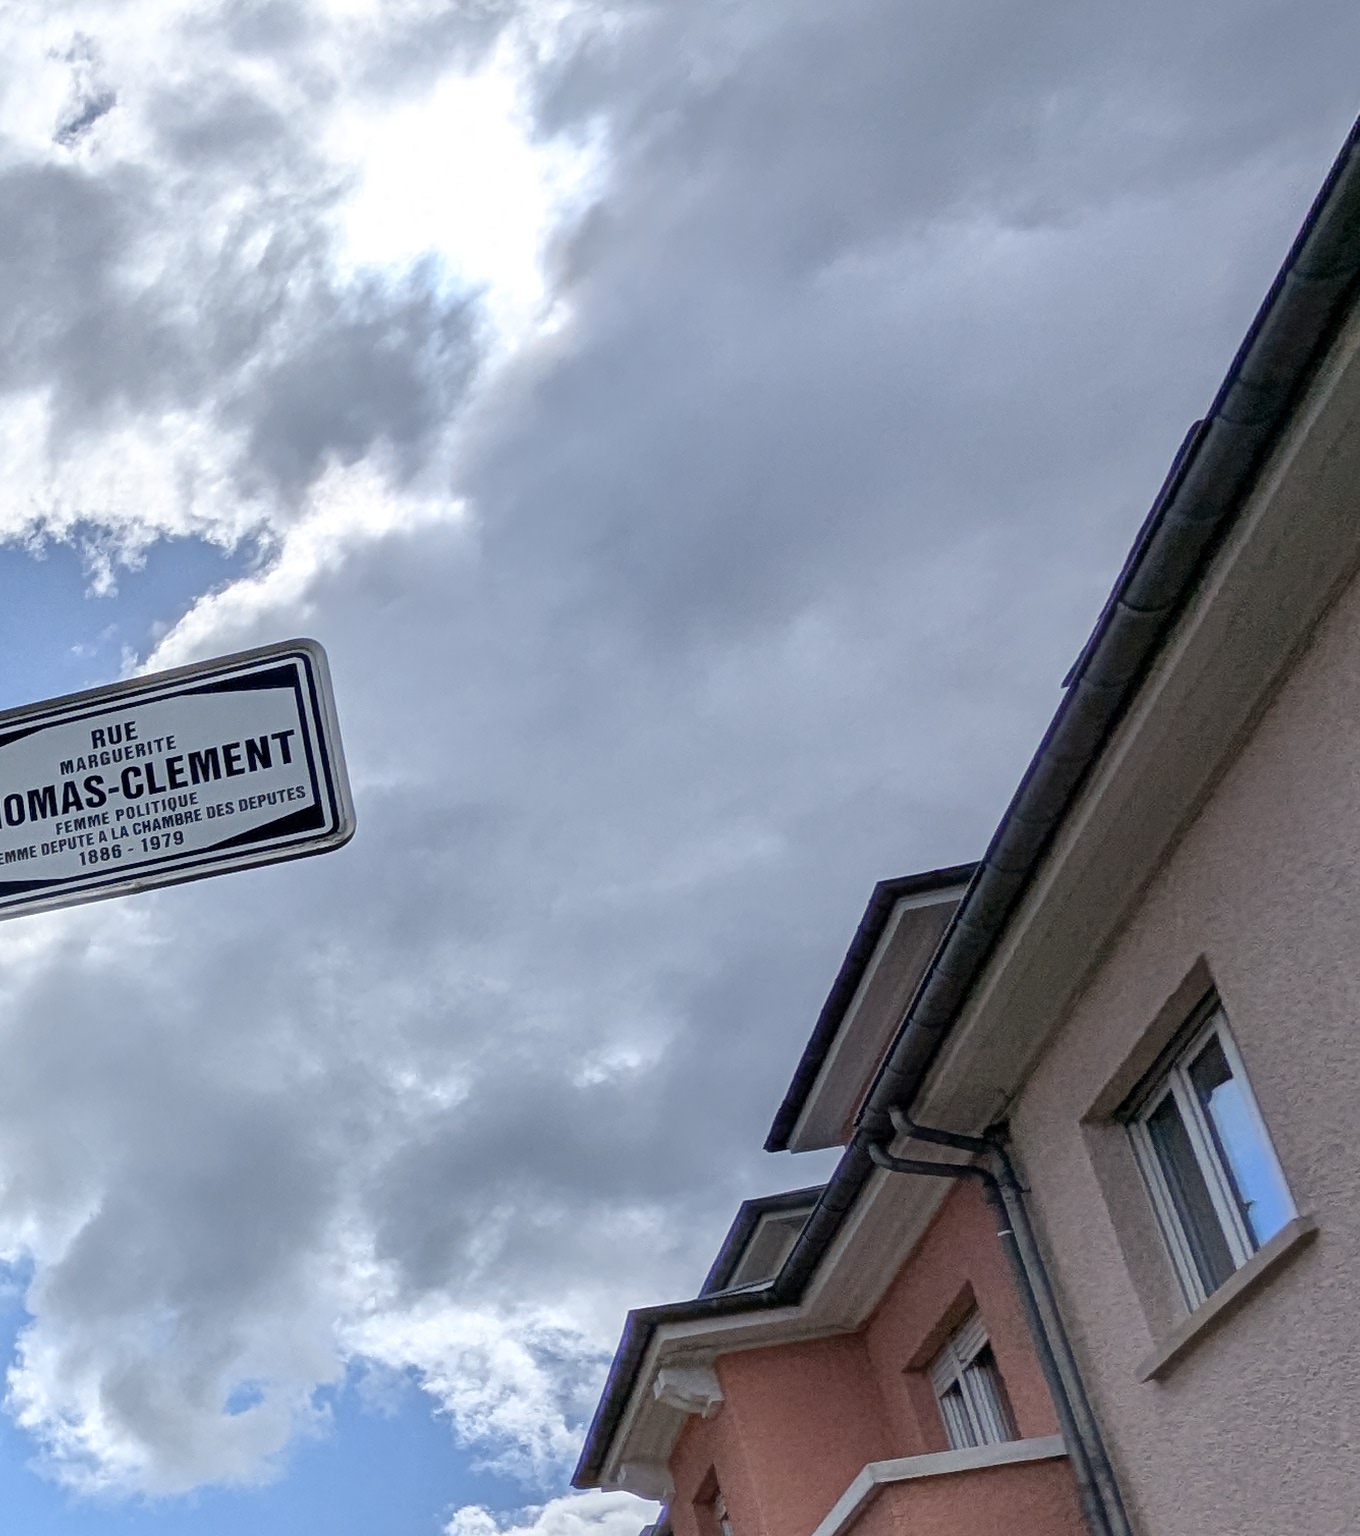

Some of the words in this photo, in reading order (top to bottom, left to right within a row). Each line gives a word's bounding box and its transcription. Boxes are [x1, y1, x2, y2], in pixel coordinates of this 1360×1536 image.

[91, 720, 138, 749] RUE
[60, 735, 176, 775] MARGUERITE
[41, 832, 95, 856] DEPUTE
[98, 831, 108, 844] A
[111, 825, 129, 840] LA
[132, 808, 203, 836] CHAMBRE
[206, 801, 235, 819] DES
[238, 785, 306, 812] DEPUTES
[56, 811, 110, 835] FEMME
[115, 792, 199, 822] POLITIQUE
[79, 844, 123, 866] 1886
[140, 831, 185, 853] 1979
